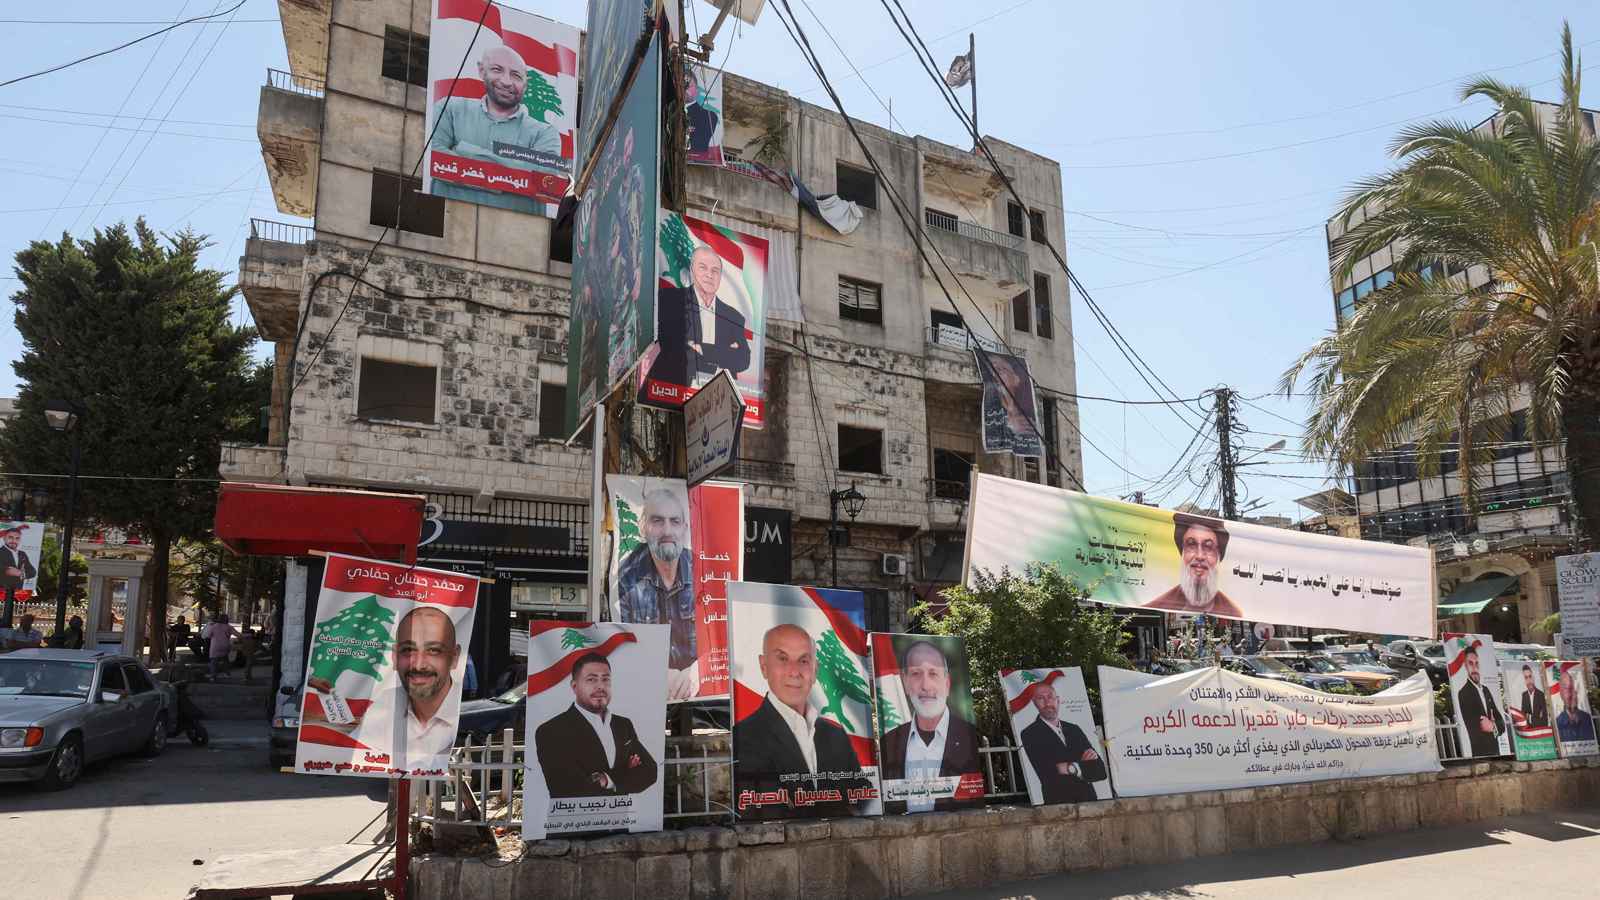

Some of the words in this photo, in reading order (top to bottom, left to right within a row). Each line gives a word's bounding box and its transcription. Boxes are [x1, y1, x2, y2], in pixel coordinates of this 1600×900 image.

[461, 167, 485, 179] خضر
[487, 175, 528, 189] المهندس
[651, 382, 678, 398] الدين
[417, 502, 444, 548] 3
[744, 519, 784, 545] UM
[699, 550, 731, 561] خدمة
[700, 570, 732, 585] الناس
[702, 592, 728, 606] ي
[703, 611, 728, 625] ساس
[1189, 686, 1232, 702] والامتنان
[1235, 685, 1261, 702] الشكر
[1143, 708, 1187, 734] الكريم
[1191, 708, 1236, 728] لدعمه
[1313, 708, 1348, 728] بركات
[1352, 716, 1383, 726] محمد
[1386, 706, 1413, 728] للحاج
[1194, 742, 1214, 755] 350
[1216, 744, 1234, 757] من
[1234, 737, 1251, 757] أكثر
[1281, 742, 1300, 757] الذي
[1303, 739, 1343, 756] الكهربائي
[1416, 736, 1428, 749] في
[1165, 743, 1192, 759] وحدة
[609, 796, 633, 809] فضل
[738, 788, 790, 811] الصباغ
[794, 787, 842, 807] حسين
[847, 786, 880, 805] علي
[550, 801, 576, 814] بيطار
[579, 799, 606, 812] نجيب
